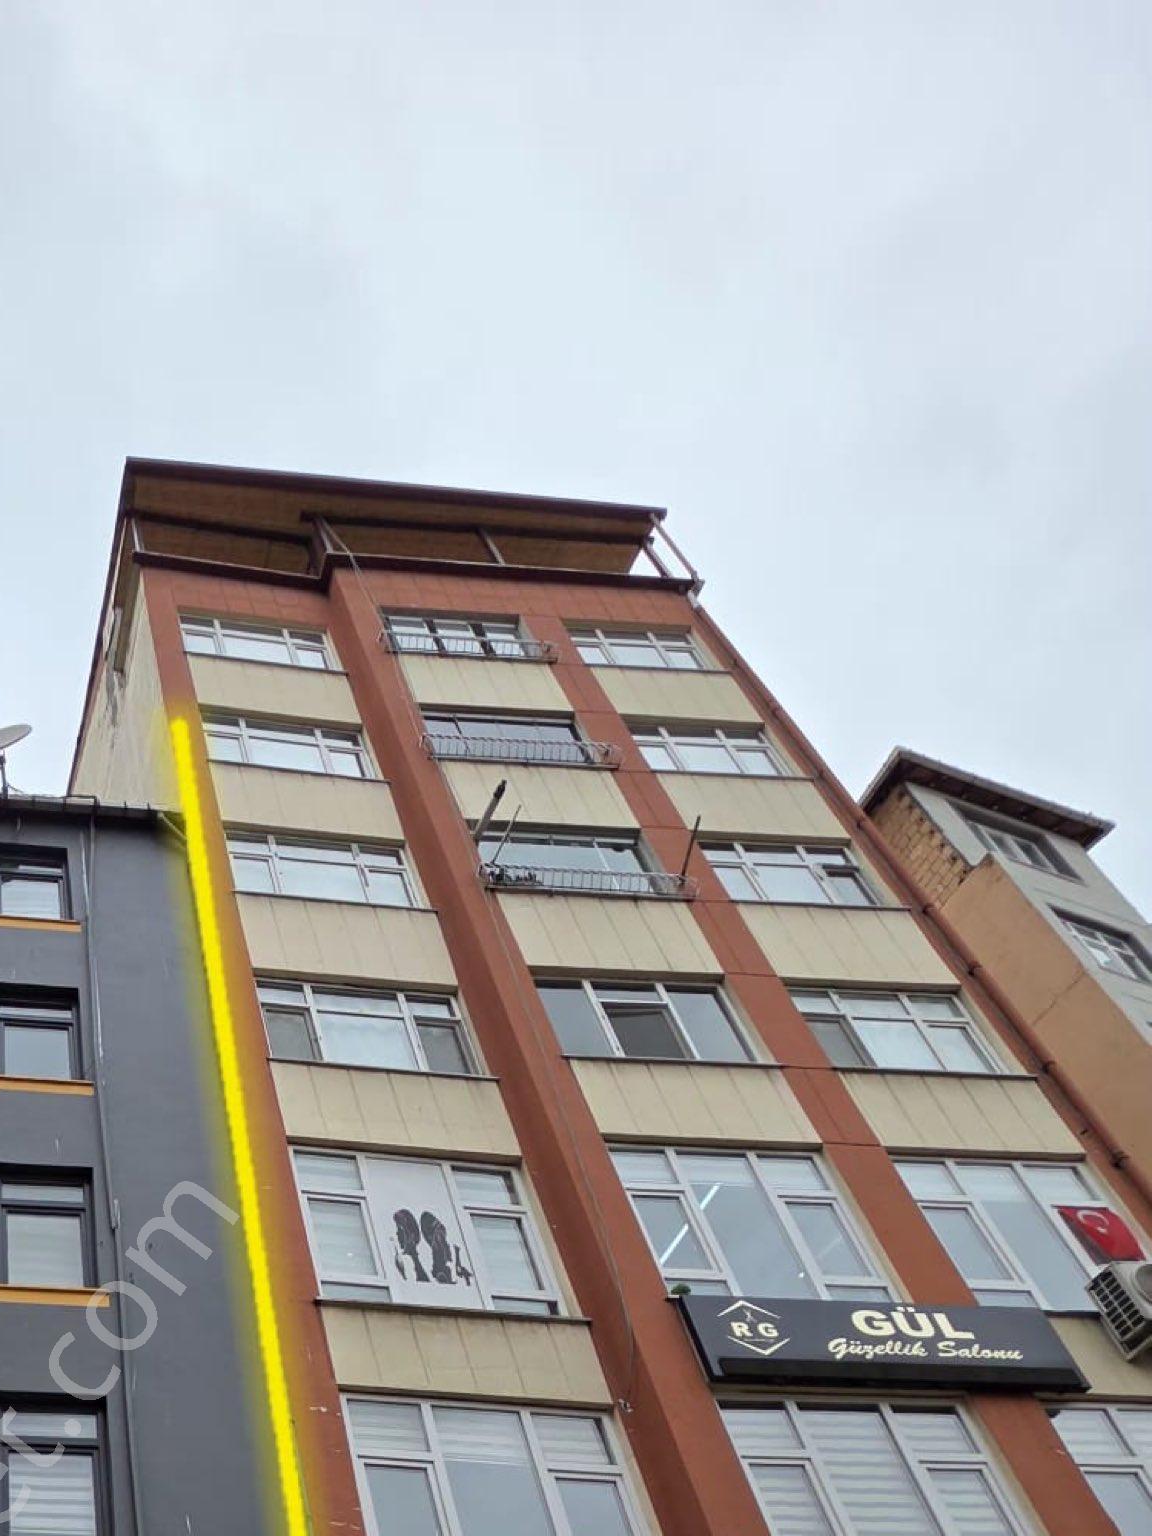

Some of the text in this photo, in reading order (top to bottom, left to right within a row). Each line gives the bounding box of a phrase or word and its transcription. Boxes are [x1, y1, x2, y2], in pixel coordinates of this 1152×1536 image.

[851, 1306, 975, 1340] GÜL
[827, 1338, 1024, 1361] Güzellik Salonu
